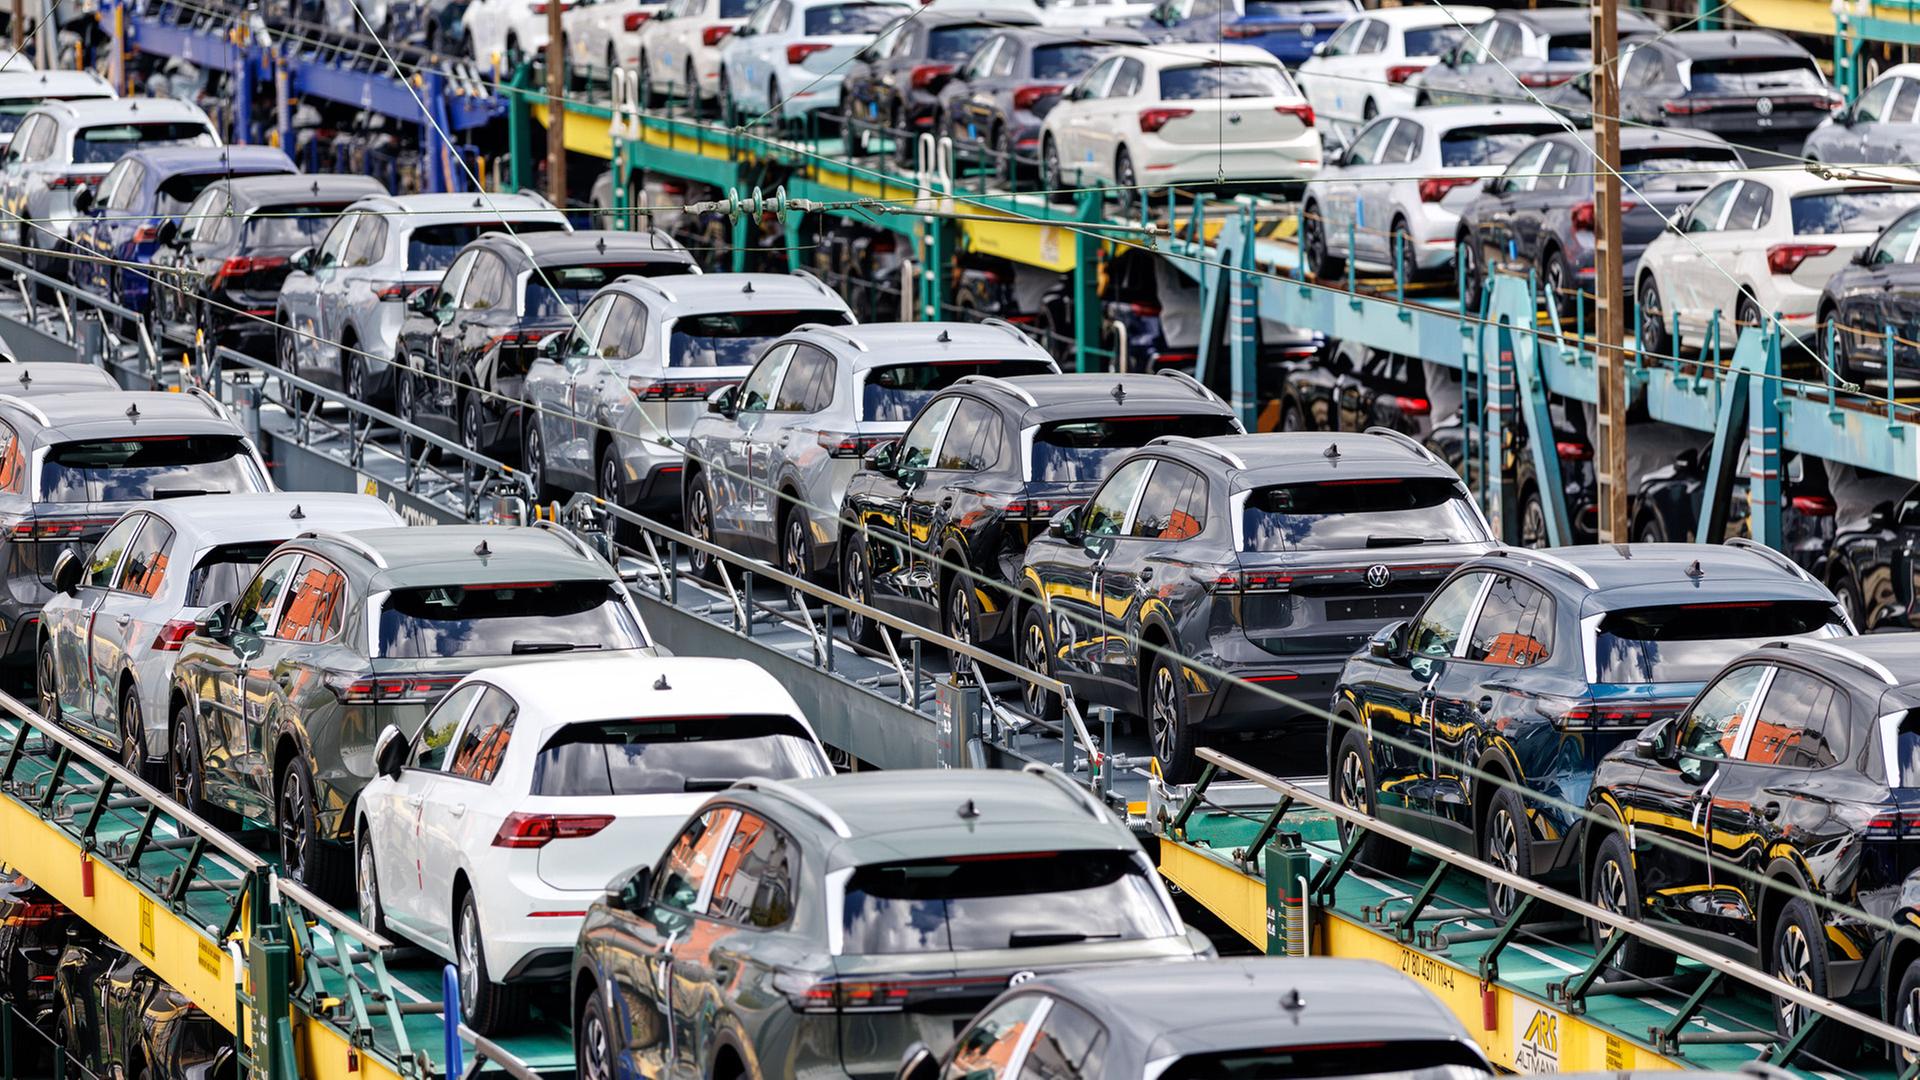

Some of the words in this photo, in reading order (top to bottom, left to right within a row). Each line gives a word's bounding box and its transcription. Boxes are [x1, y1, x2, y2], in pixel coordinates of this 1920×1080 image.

[1368, 564, 1390, 588] VW
[1402, 949, 1410, 973] 27
[1412, 953, 1420, 977] 80
[1523, 1009, 1557, 1053] ARS
